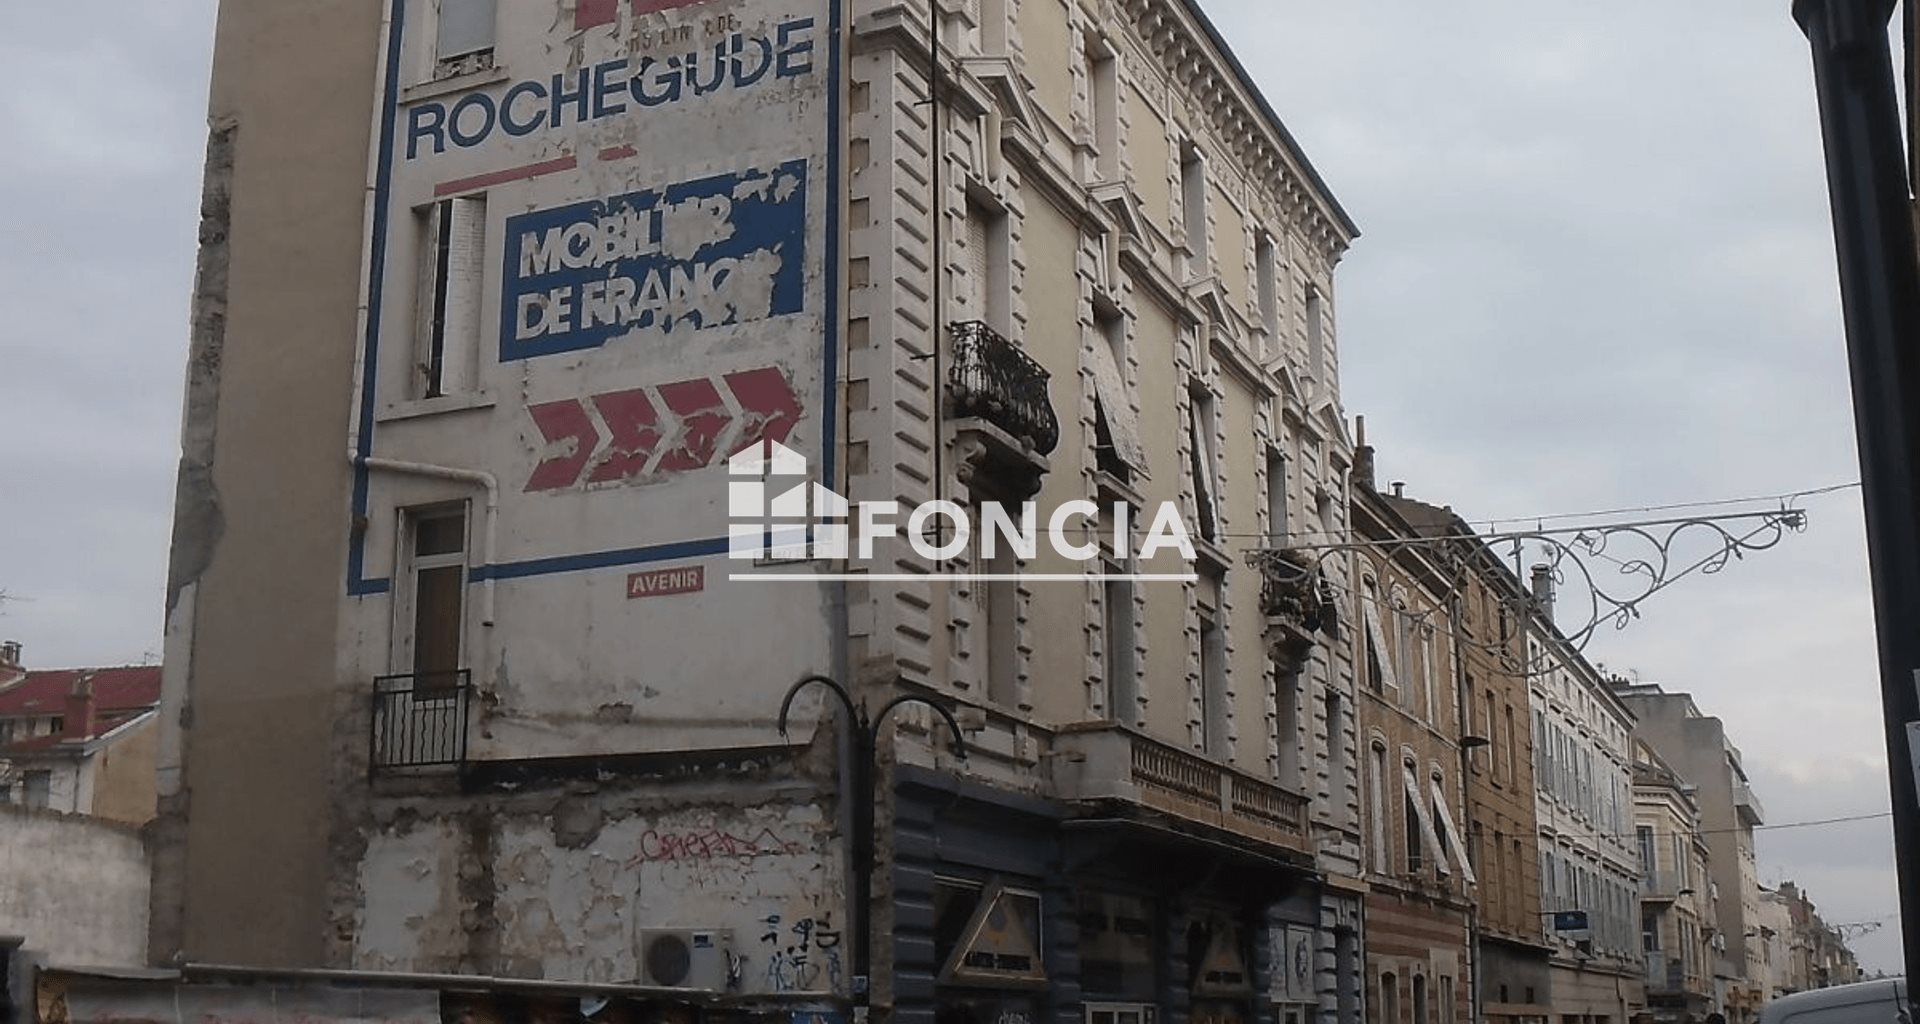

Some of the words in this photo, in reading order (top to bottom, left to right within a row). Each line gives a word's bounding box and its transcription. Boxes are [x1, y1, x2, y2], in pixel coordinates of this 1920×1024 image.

[406, 17, 815, 160] ROCHEGUDE
[515, 286, 572, 340] DE
[632, 570, 698, 594] AVENIR
